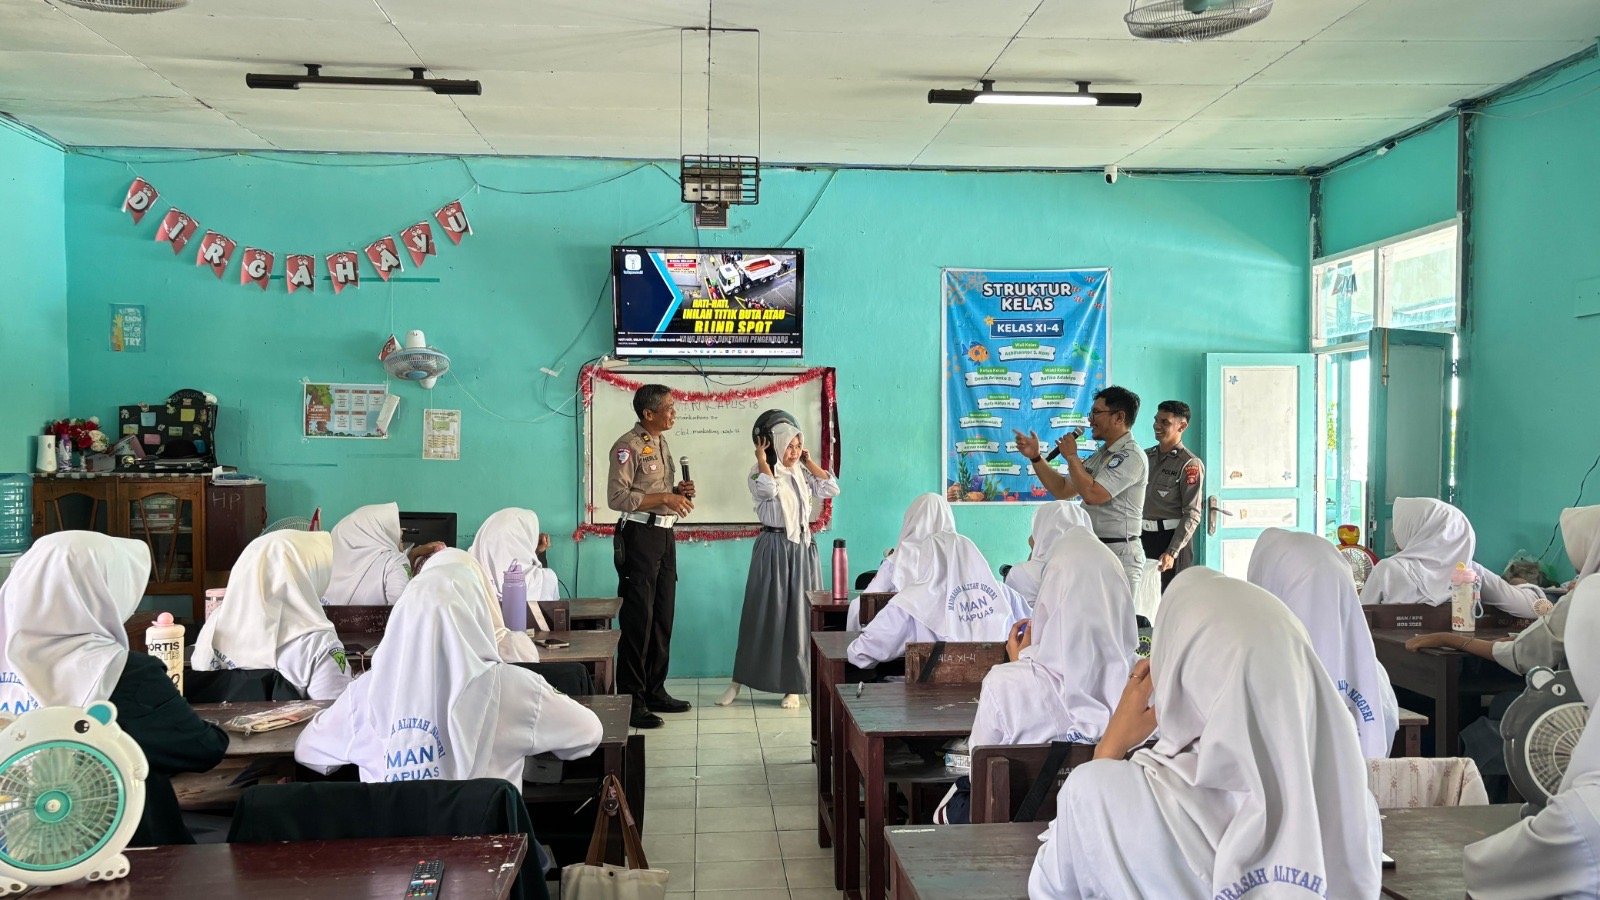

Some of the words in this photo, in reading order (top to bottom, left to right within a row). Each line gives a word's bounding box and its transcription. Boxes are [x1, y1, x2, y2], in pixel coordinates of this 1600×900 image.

[127, 191, 467, 287] DIRGAHAYU
[983, 282, 1072, 297] STRUKTUR
[1001, 297, 1054, 312] KELAS
[682, 309, 713, 319] INILAH
[714, 309, 738, 319] TITIK
[738, 310, 762, 320] BUTA
[763, 310, 785, 320] ATAU
[694, 320, 735, 333] BLIND
[737, 320, 773, 334] SPOT
[997, 324, 1033, 333] KELAS
[1035, 323, 1059, 333] XI-4
[123, 337, 142, 346] TRY
[959, 596, 988, 612] MAN
[958, 606, 994, 622] KAPUAS
[0, 700, 30, 716] AN
[1347, 687, 1375, 723] NEGERI
[398, 717, 431, 732] ALIYAH
[386, 745, 434, 769] MAN
[1273, 865, 1323, 893] ALIYAH
